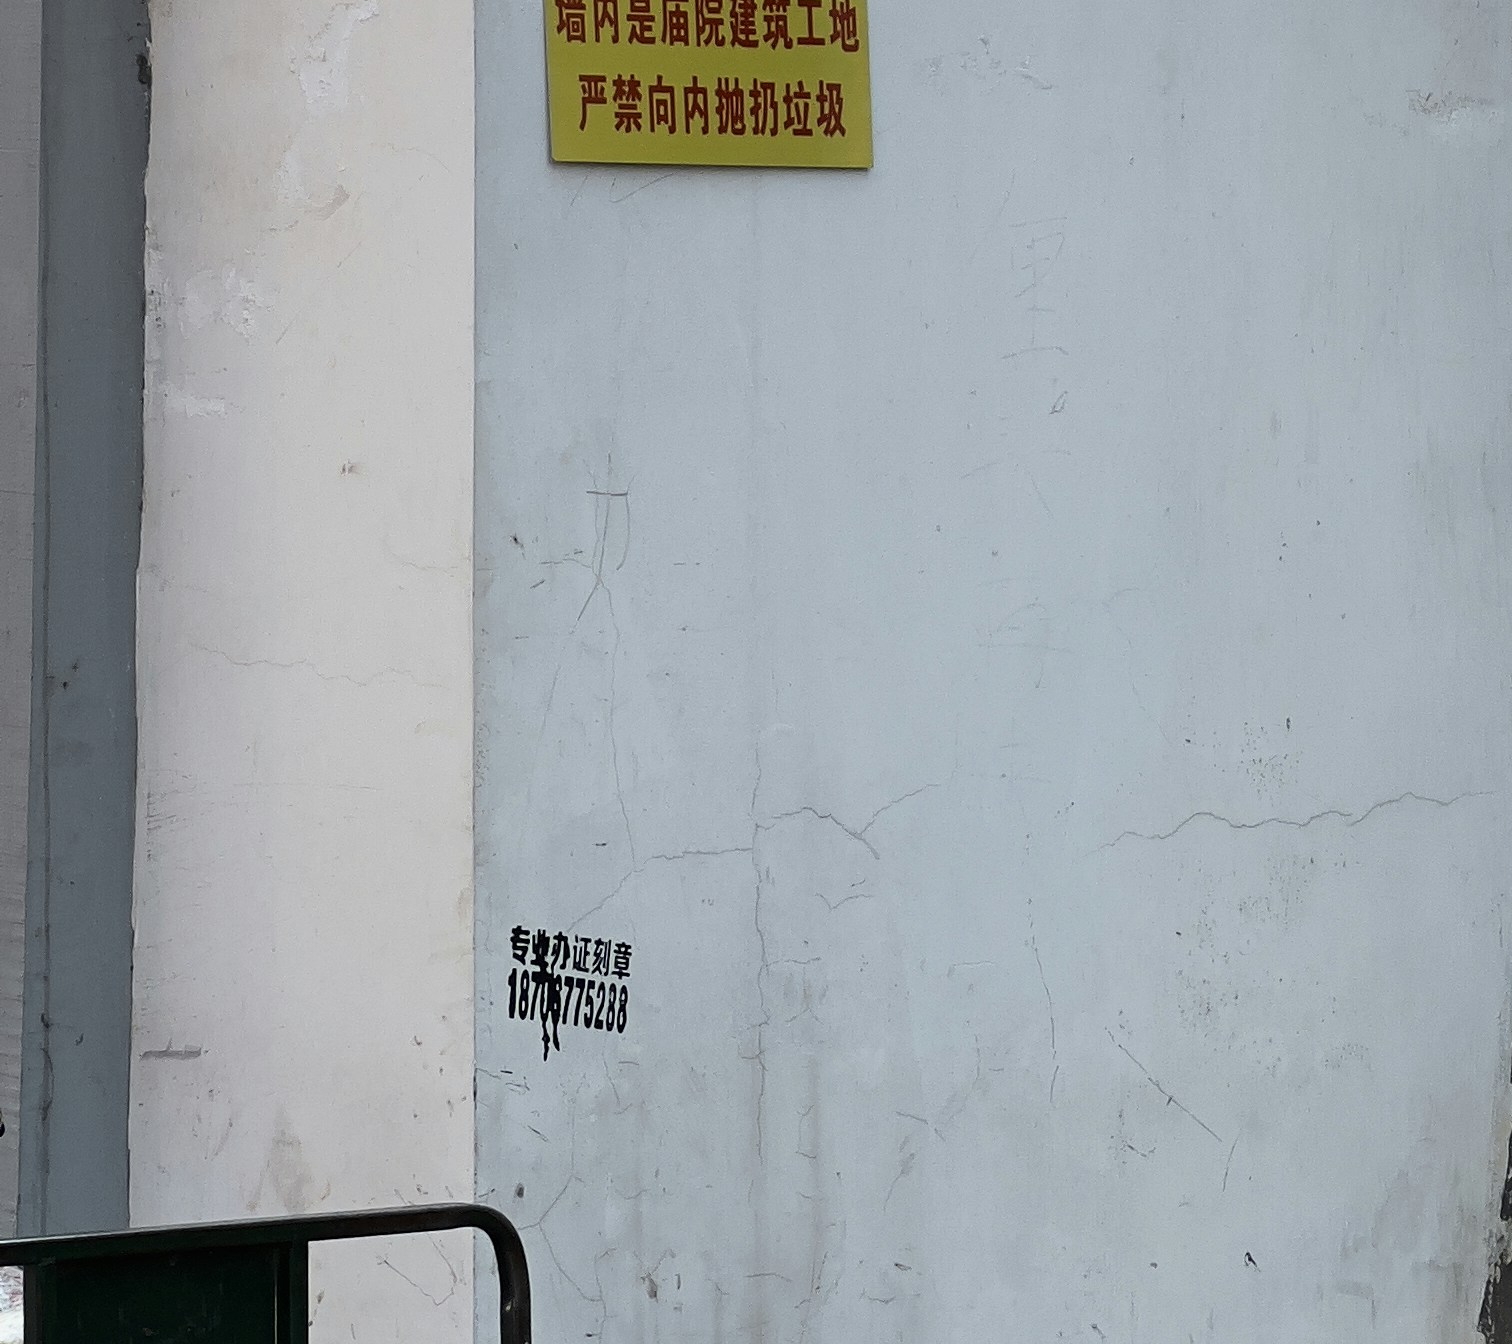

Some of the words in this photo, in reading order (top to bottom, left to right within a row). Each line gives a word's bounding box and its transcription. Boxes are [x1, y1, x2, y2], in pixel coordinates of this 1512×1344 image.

[578, 73, 847, 138] 严禁向内抛扔垃圾
[510, 925, 633, 980] 专业办证刻章
